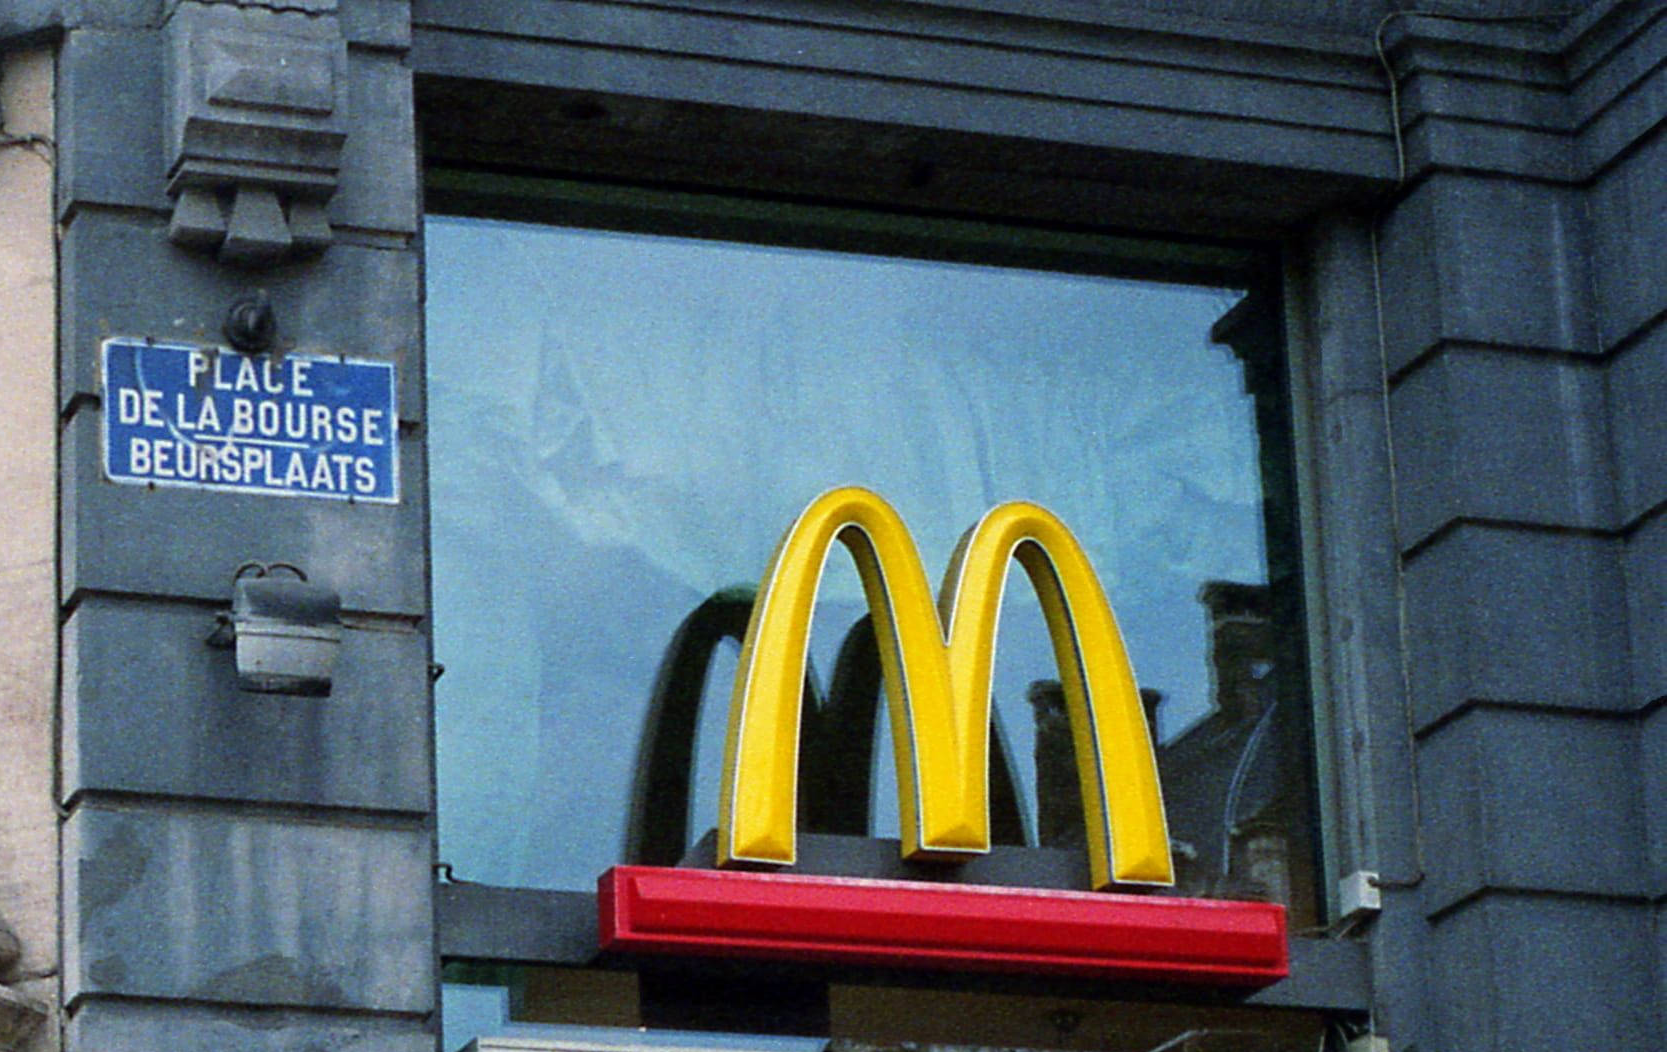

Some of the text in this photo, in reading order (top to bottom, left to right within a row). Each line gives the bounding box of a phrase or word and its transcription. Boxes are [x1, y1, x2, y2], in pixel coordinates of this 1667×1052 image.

[188, 352, 314, 397] PLACE
[118, 388, 384, 445] DE LA BOURSE
[130, 438, 377, 493] BEURSPLAATS
